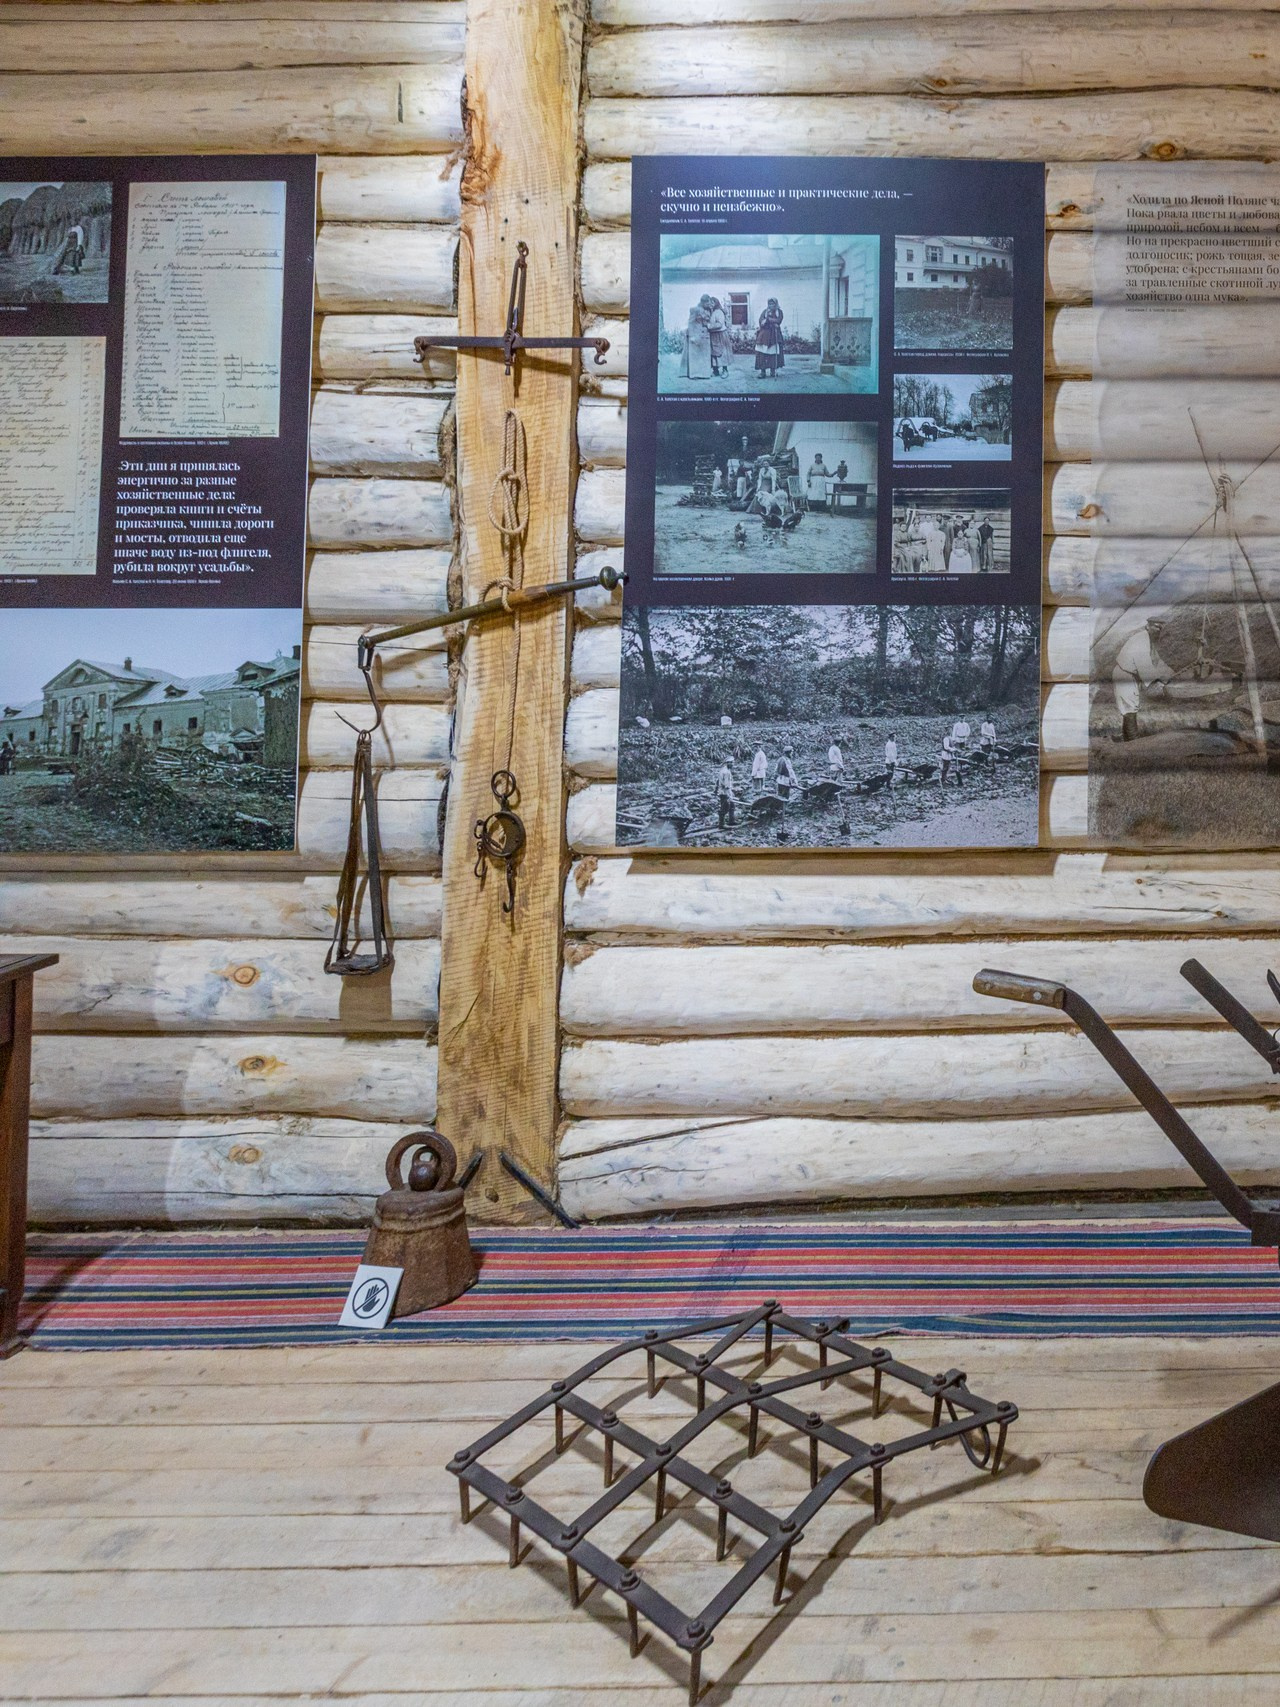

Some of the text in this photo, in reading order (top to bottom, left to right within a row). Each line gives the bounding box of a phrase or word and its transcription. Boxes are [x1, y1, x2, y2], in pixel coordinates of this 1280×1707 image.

[660, 187, 686, 198] «Все
[688, 186, 775, 198] хозяйственные
[777, 189, 785, 198] и
[788, 189, 869, 201] практические
[1173, 196, 1188, 205] по
[1190, 194, 1224, 206] Ясной
[1227, 195, 1267, 206] Поляне
[660, 203, 700, 214] скучно
[702, 203, 710, 212] и
[1126, 207, 1154, 218] Пока
[1156, 210, 1188, 221] рвала
[1191, 210, 1226, 221] цветы
[1228, 210, 1236, 219] и
[1185, 222, 1220, 233] небом
[1223, 225, 1230, 233] и
[1233, 225, 1260, 234] всем
[1126, 235, 1141, 246] Но
[1144, 237, 1157, 246] на
[1160, 237, 1219, 249] прекрасно
[1195, 252, 1225, 263] рожь
[1181, 265, 1188, 274] с
[1190, 265, 1263, 278] крестьянами
[1125, 278, 1137, 287] за
[1141, 279, 1207, 290] травленные
[1209, 277, 1263, 288] скотиной
[1125, 289, 1182, 301] хозяйство
[1184, 292, 1210, 304] одна
[144, 462, 167, 474] дни
[169, 462, 177, 471] я
[179, 462, 241, 474] принялась
[117, 477, 237, 488] энергично за разные
[116, 489, 204, 500] хозяйственные
[115, 503, 262, 517] проверяла книги и счёты
[189, 520, 231, 529] чинила
[233, 520, 275, 531] дороги
[114, 535, 122, 543] и
[167, 535, 221, 546] отводила
[223, 535, 247, 546] еще
[113, 549, 148, 558] иначе
[150, 549, 174, 560] воду
[178, 549, 218, 560] из-под
[112, 562, 154, 575] рубила
[156, 564, 193, 575] вокруг
